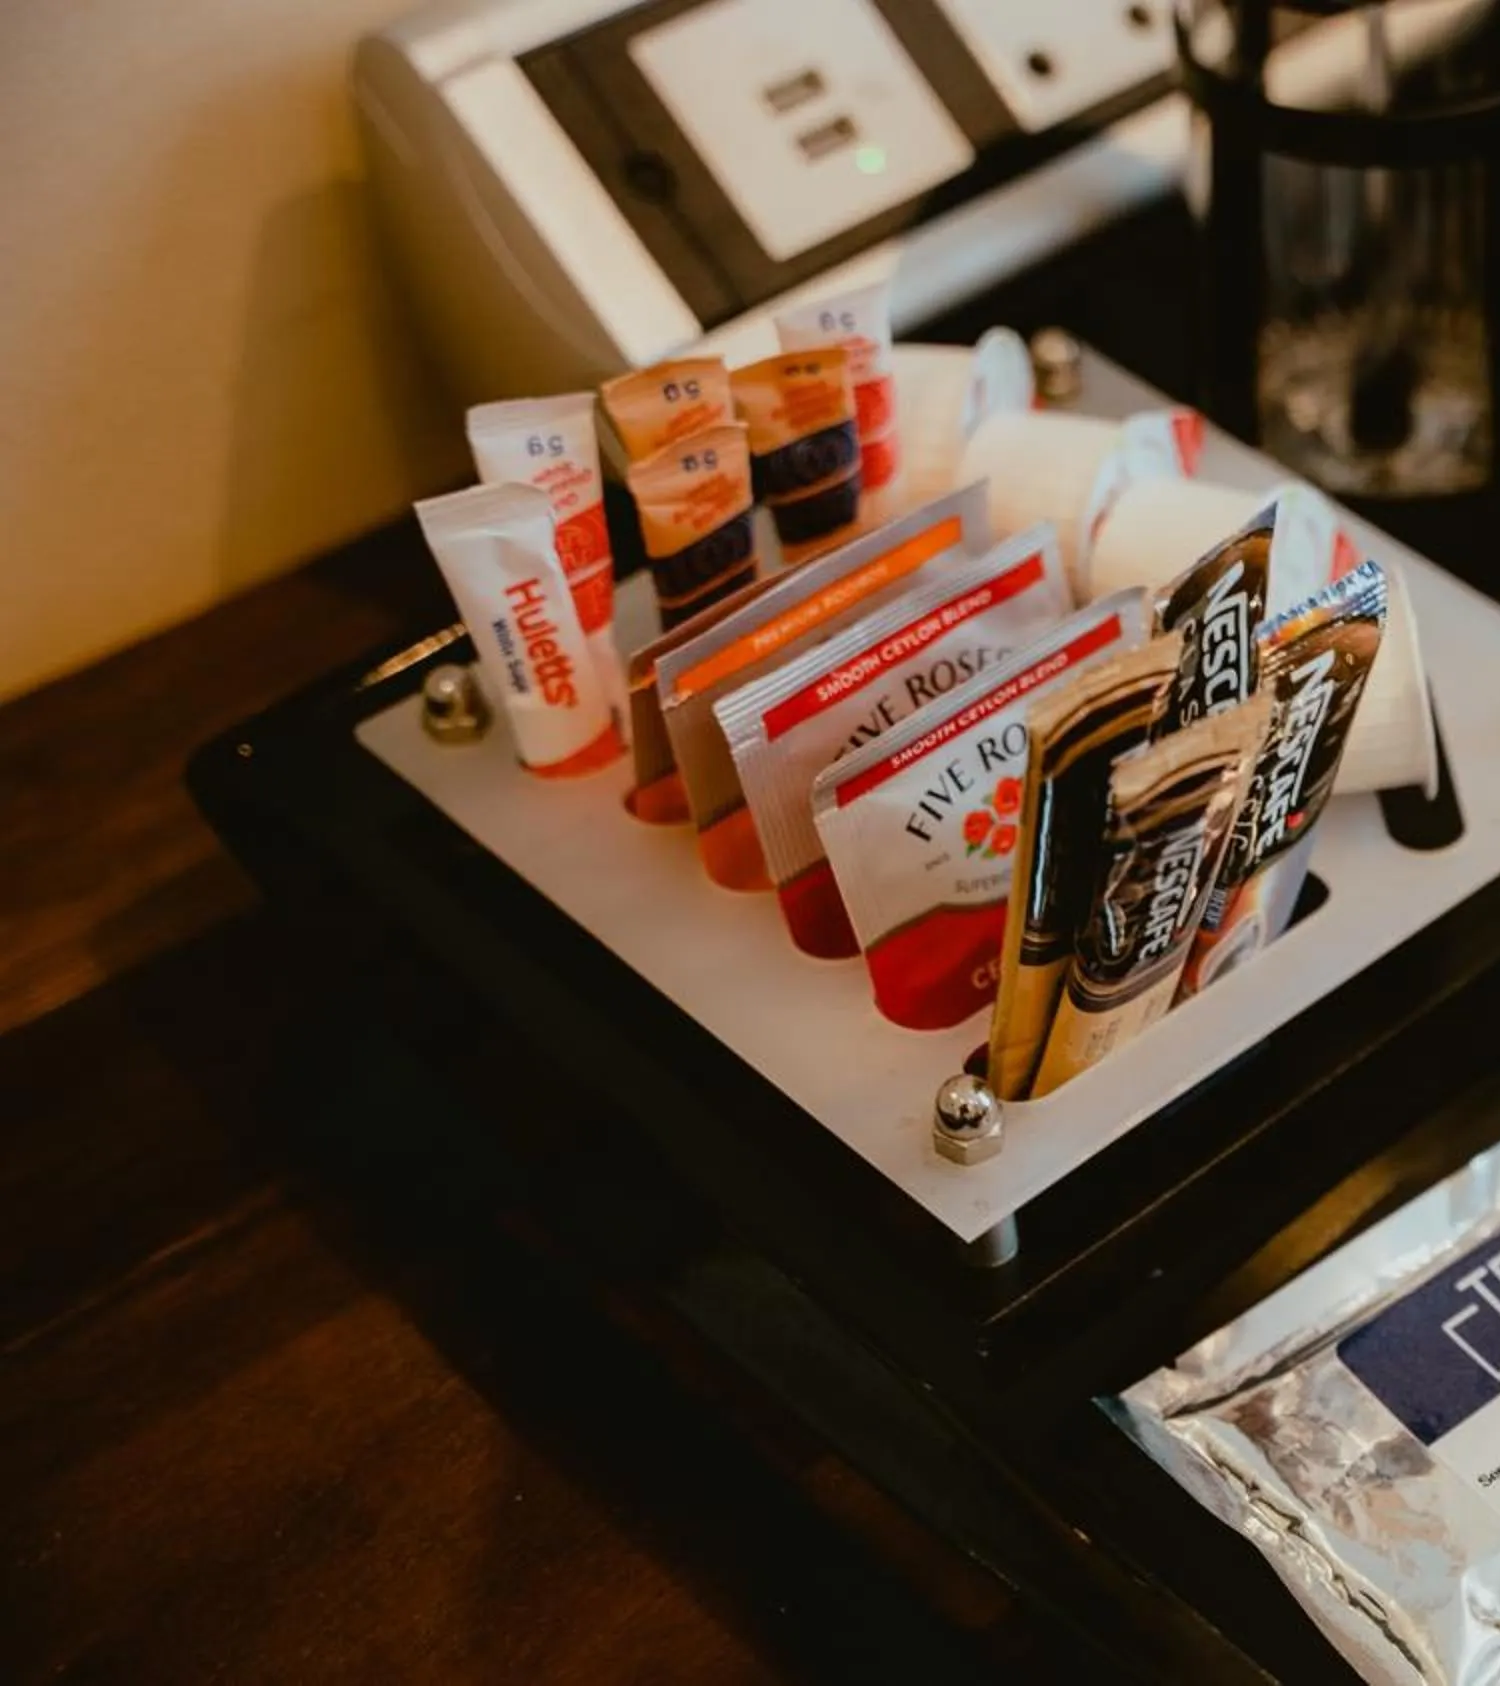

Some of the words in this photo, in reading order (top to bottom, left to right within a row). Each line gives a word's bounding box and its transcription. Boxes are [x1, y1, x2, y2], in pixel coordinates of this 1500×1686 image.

[525, 431, 564, 461] 5g
[504, 576, 578, 706] Huletts
[814, 654, 880, 701] SMOOTH
[879, 617, 942, 662] CEYLON
[939, 588, 993, 625] BLEND
[1202, 560, 1248, 716] NESC
[833, 697, 901, 760] IVE
[889, 721, 957, 768] SMOOTH
[956, 682, 1019, 726] CEYLON
[1017, 652, 1069, 689] BLEND
[905, 757, 976, 842] FIVE
